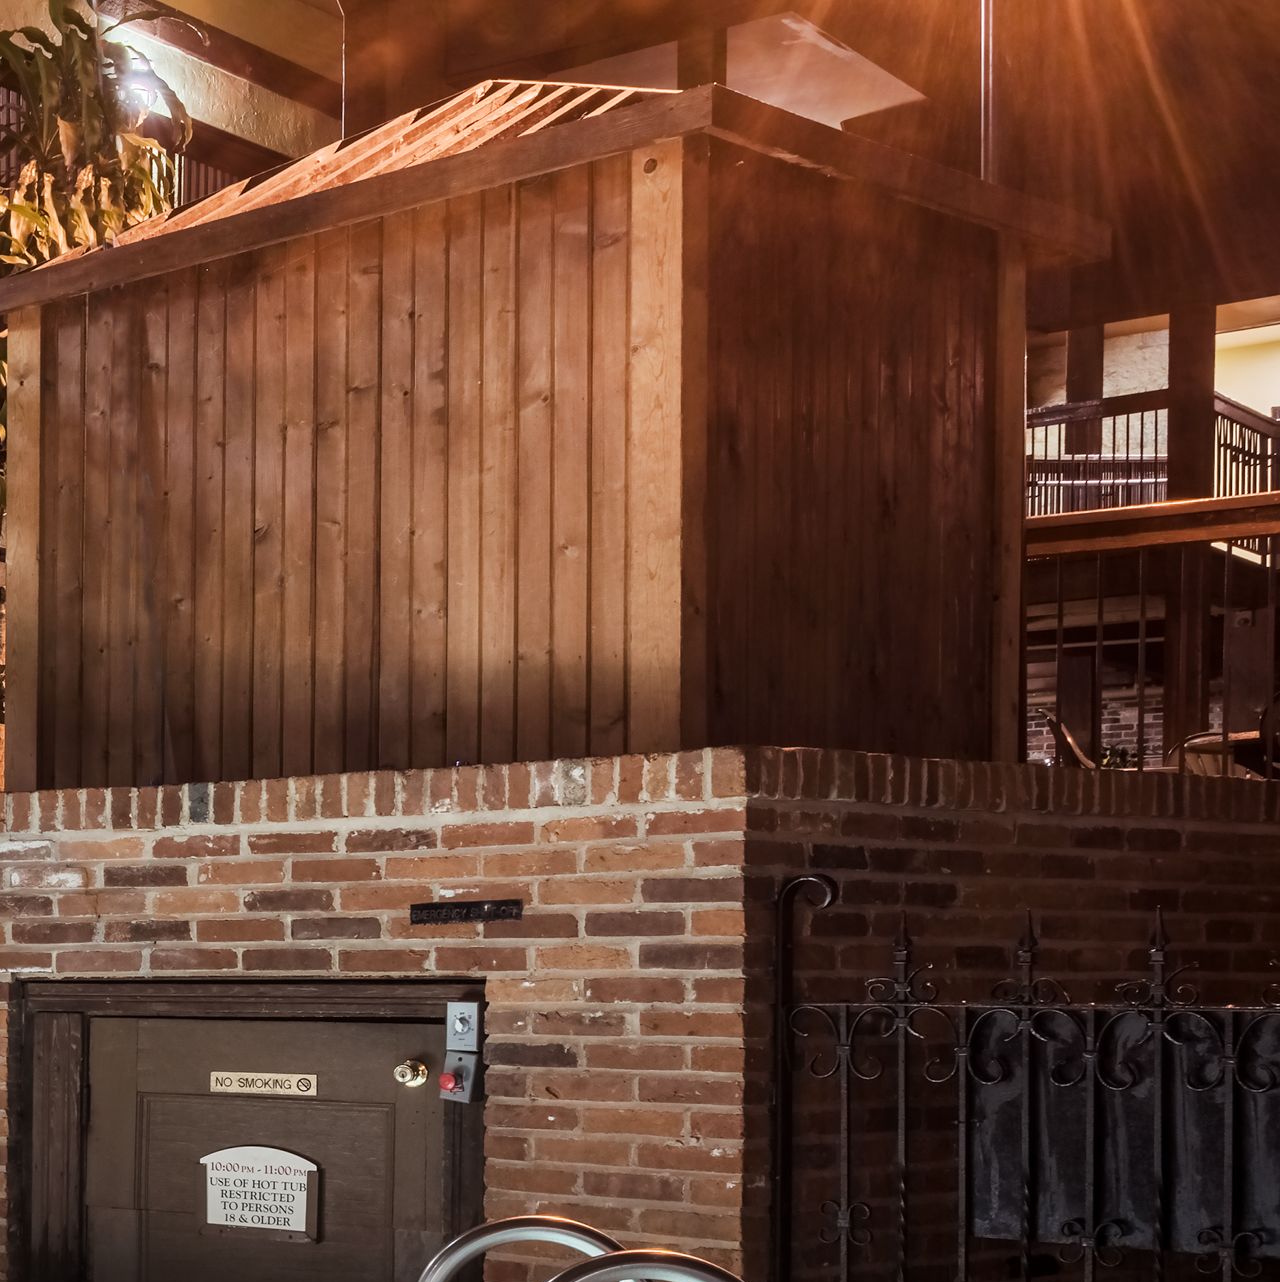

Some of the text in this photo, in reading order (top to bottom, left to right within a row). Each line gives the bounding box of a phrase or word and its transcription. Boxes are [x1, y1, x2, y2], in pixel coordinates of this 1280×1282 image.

[215, 1077, 292, 1090] NO SMOKING
[211, 1161, 240, 1173] 10:00
[241, 1165, 254, 1173] PM
[264, 1165, 292, 1176] 11:00
[293, 1169, 307, 1177] PM
[210, 1176, 307, 1192] USE OF HOT TUB
[220, 1189, 295, 1203] RESTRICTED
[221, 1201, 294, 1215] TO PERSONS
[225, 1213, 291, 1227] 18 & OLDER
